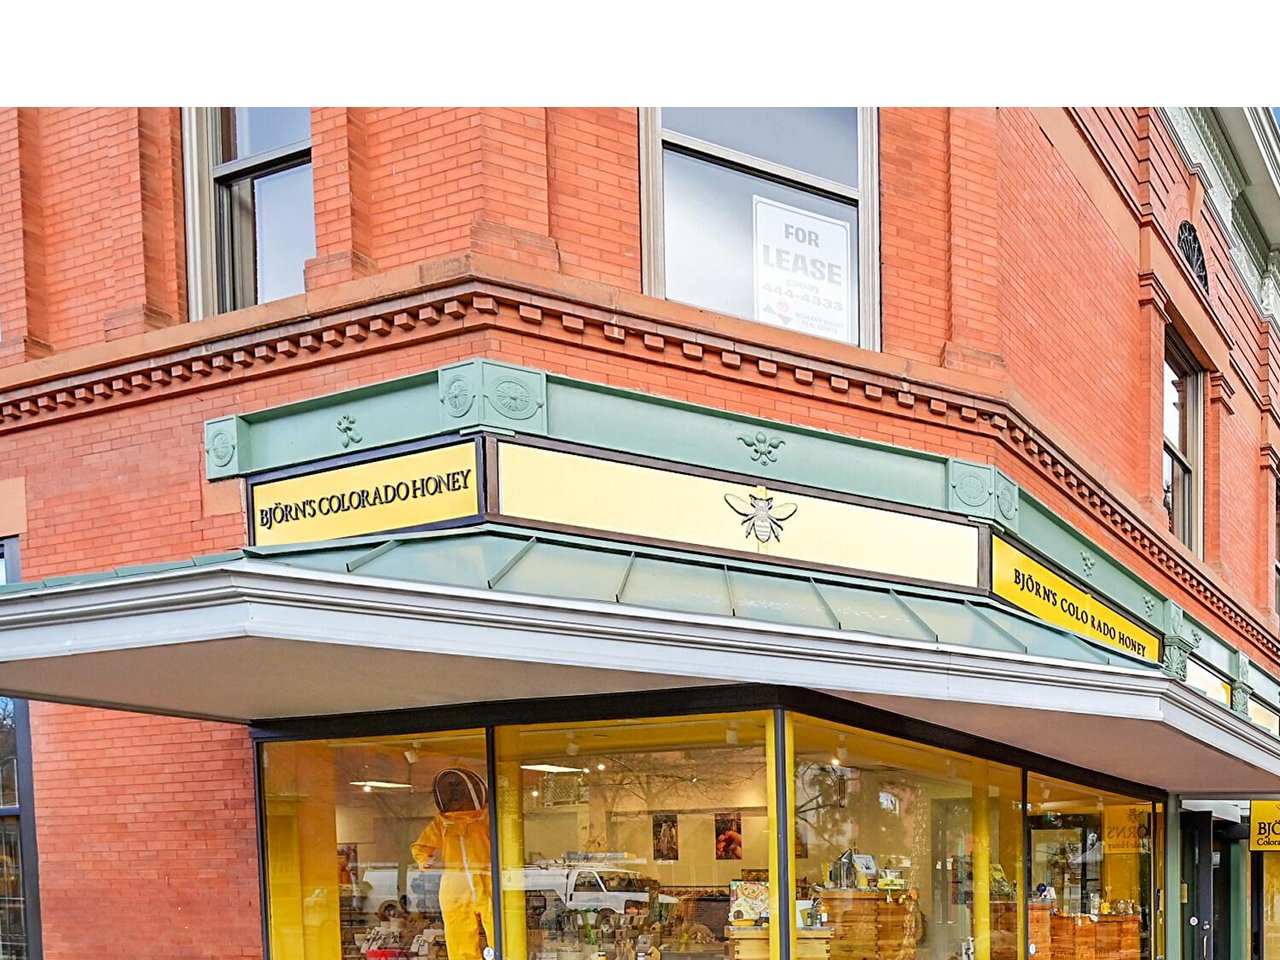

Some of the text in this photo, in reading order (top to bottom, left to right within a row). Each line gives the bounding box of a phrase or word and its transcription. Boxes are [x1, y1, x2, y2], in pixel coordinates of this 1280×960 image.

[784, 223, 820, 248] FOR
[762, 244, 842, 286] LEASE
[259, 469, 471, 529] BJÖRN'S COLORADO HONEY
[1014, 568, 1058, 607] BJÖRN'S
[1118, 631, 1146, 657] HONEY
